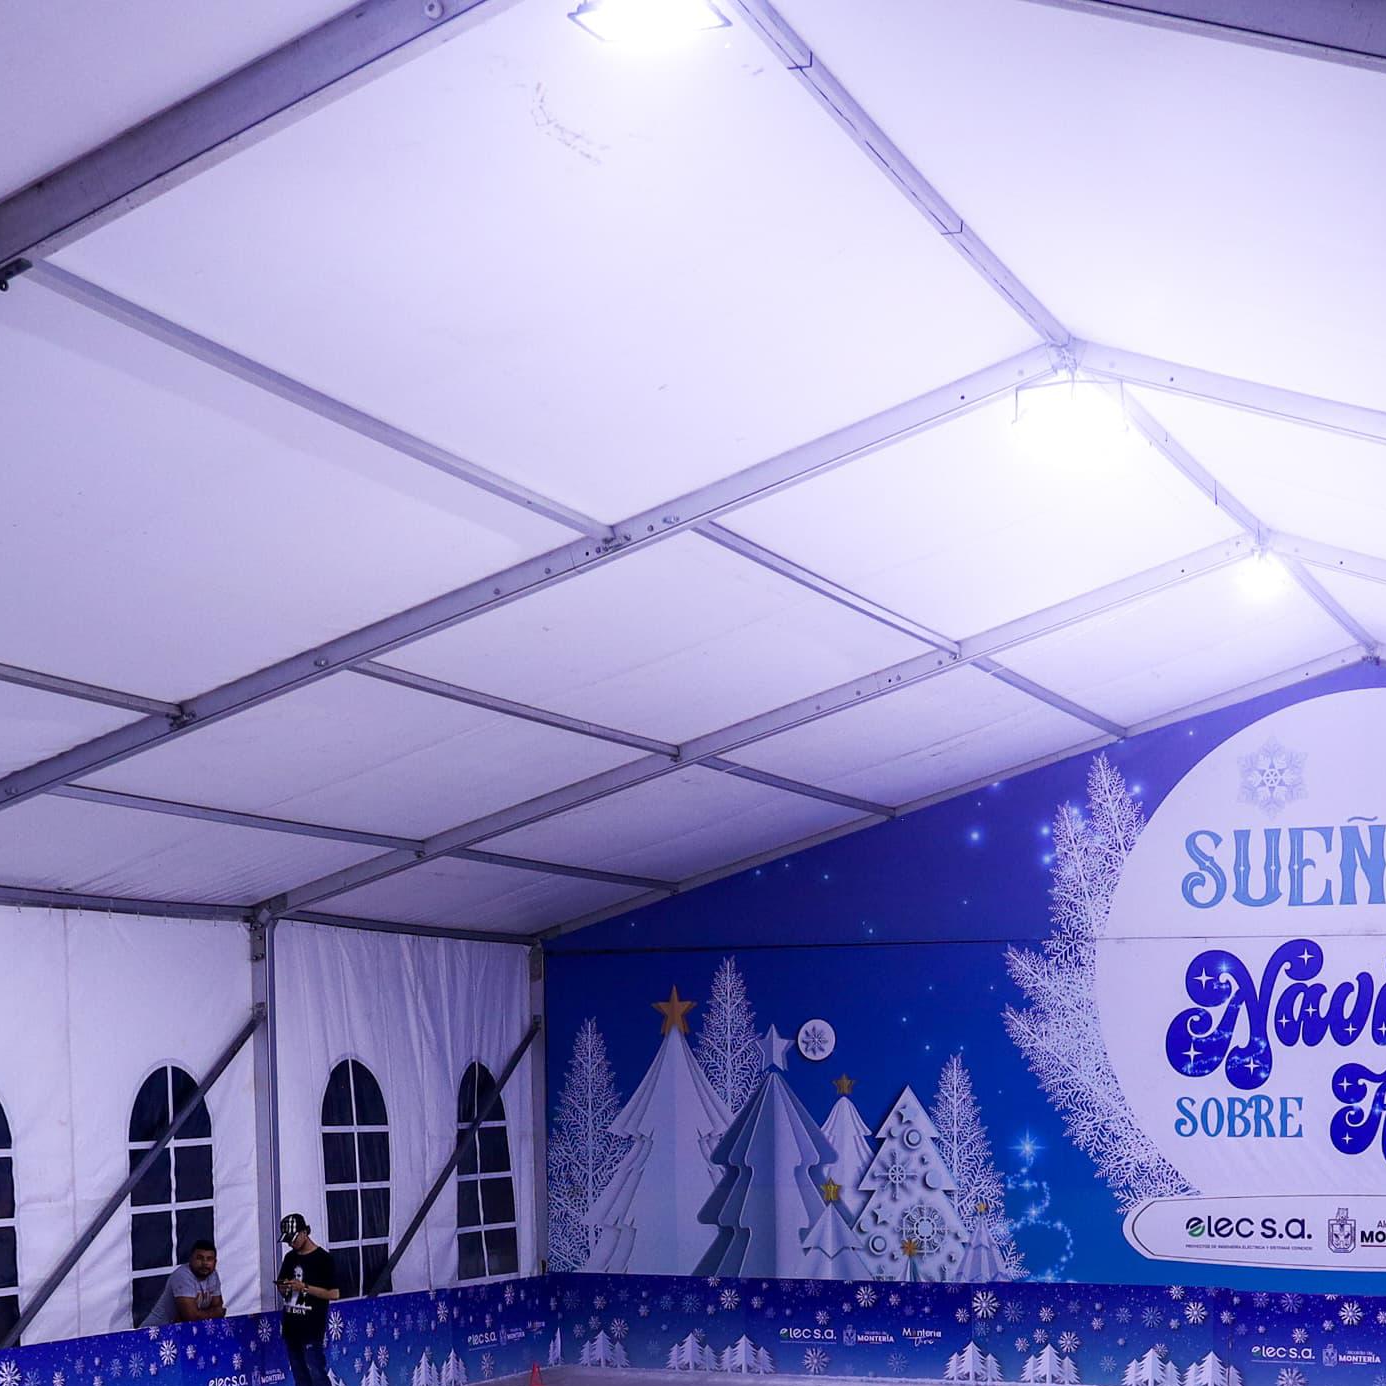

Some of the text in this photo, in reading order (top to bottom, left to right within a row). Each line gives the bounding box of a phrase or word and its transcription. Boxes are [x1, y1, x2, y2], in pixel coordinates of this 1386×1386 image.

[1174, 1094, 1304, 1139] SOBRE
[1185, 1215, 1313, 1239] elec s.a.
